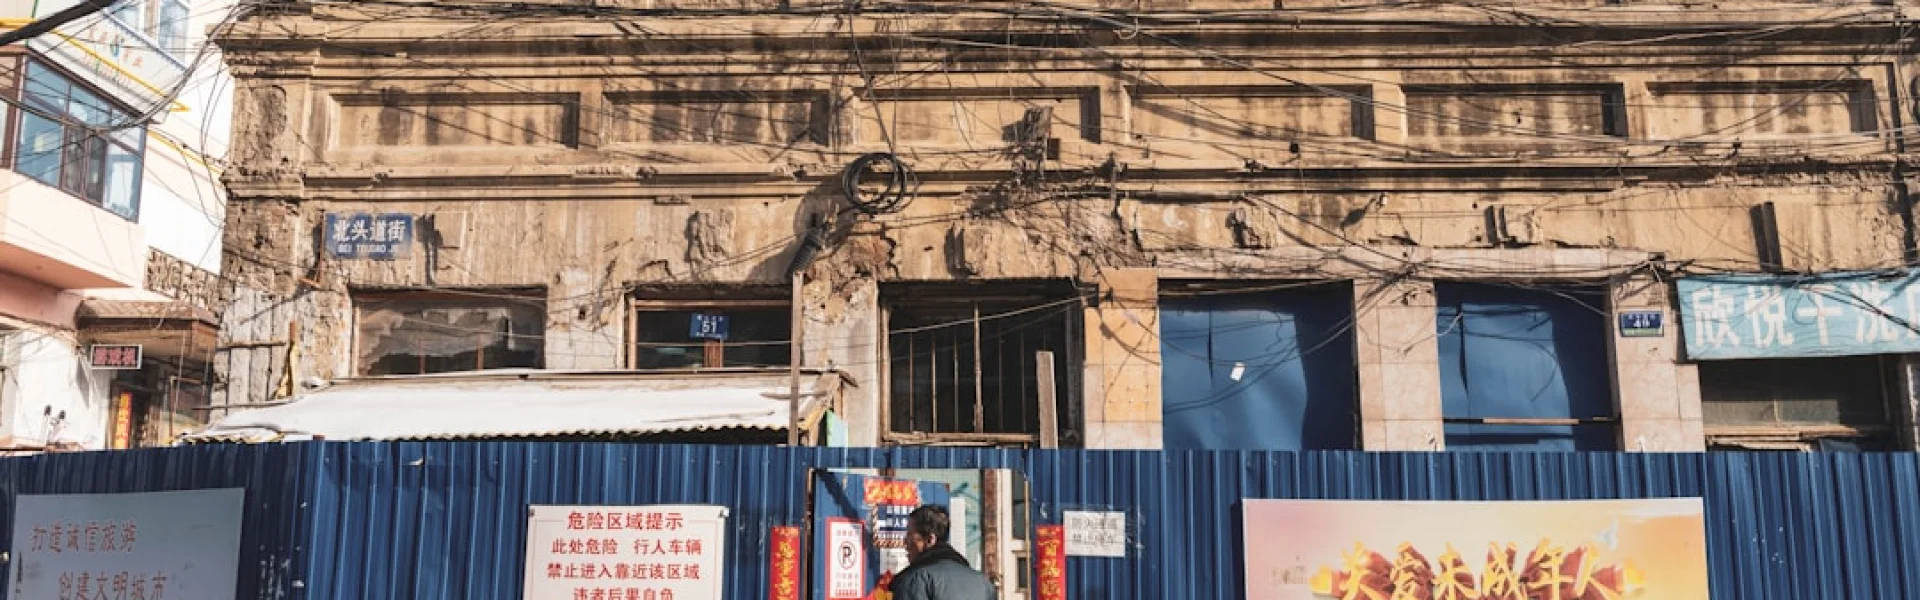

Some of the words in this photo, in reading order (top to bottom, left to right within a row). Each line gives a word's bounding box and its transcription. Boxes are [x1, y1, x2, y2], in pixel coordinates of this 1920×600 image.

[331, 218, 406, 242] 北头道街
[702, 319, 718, 333] 51
[567, 511, 684, 531] 危险区域提示
[31, 519, 137, 553] 打造诚信旅游
[552, 538, 619, 556] 此处危险
[633, 538, 703, 556] 行人车辆
[547, 562, 701, 580] 禁止进入靠近该区域
[1337, 536, 1625, 600] 关爱未成年人
[59, 569, 168, 600] 创建文明城市
[573, 586, 675, 600] 违者后果自负
